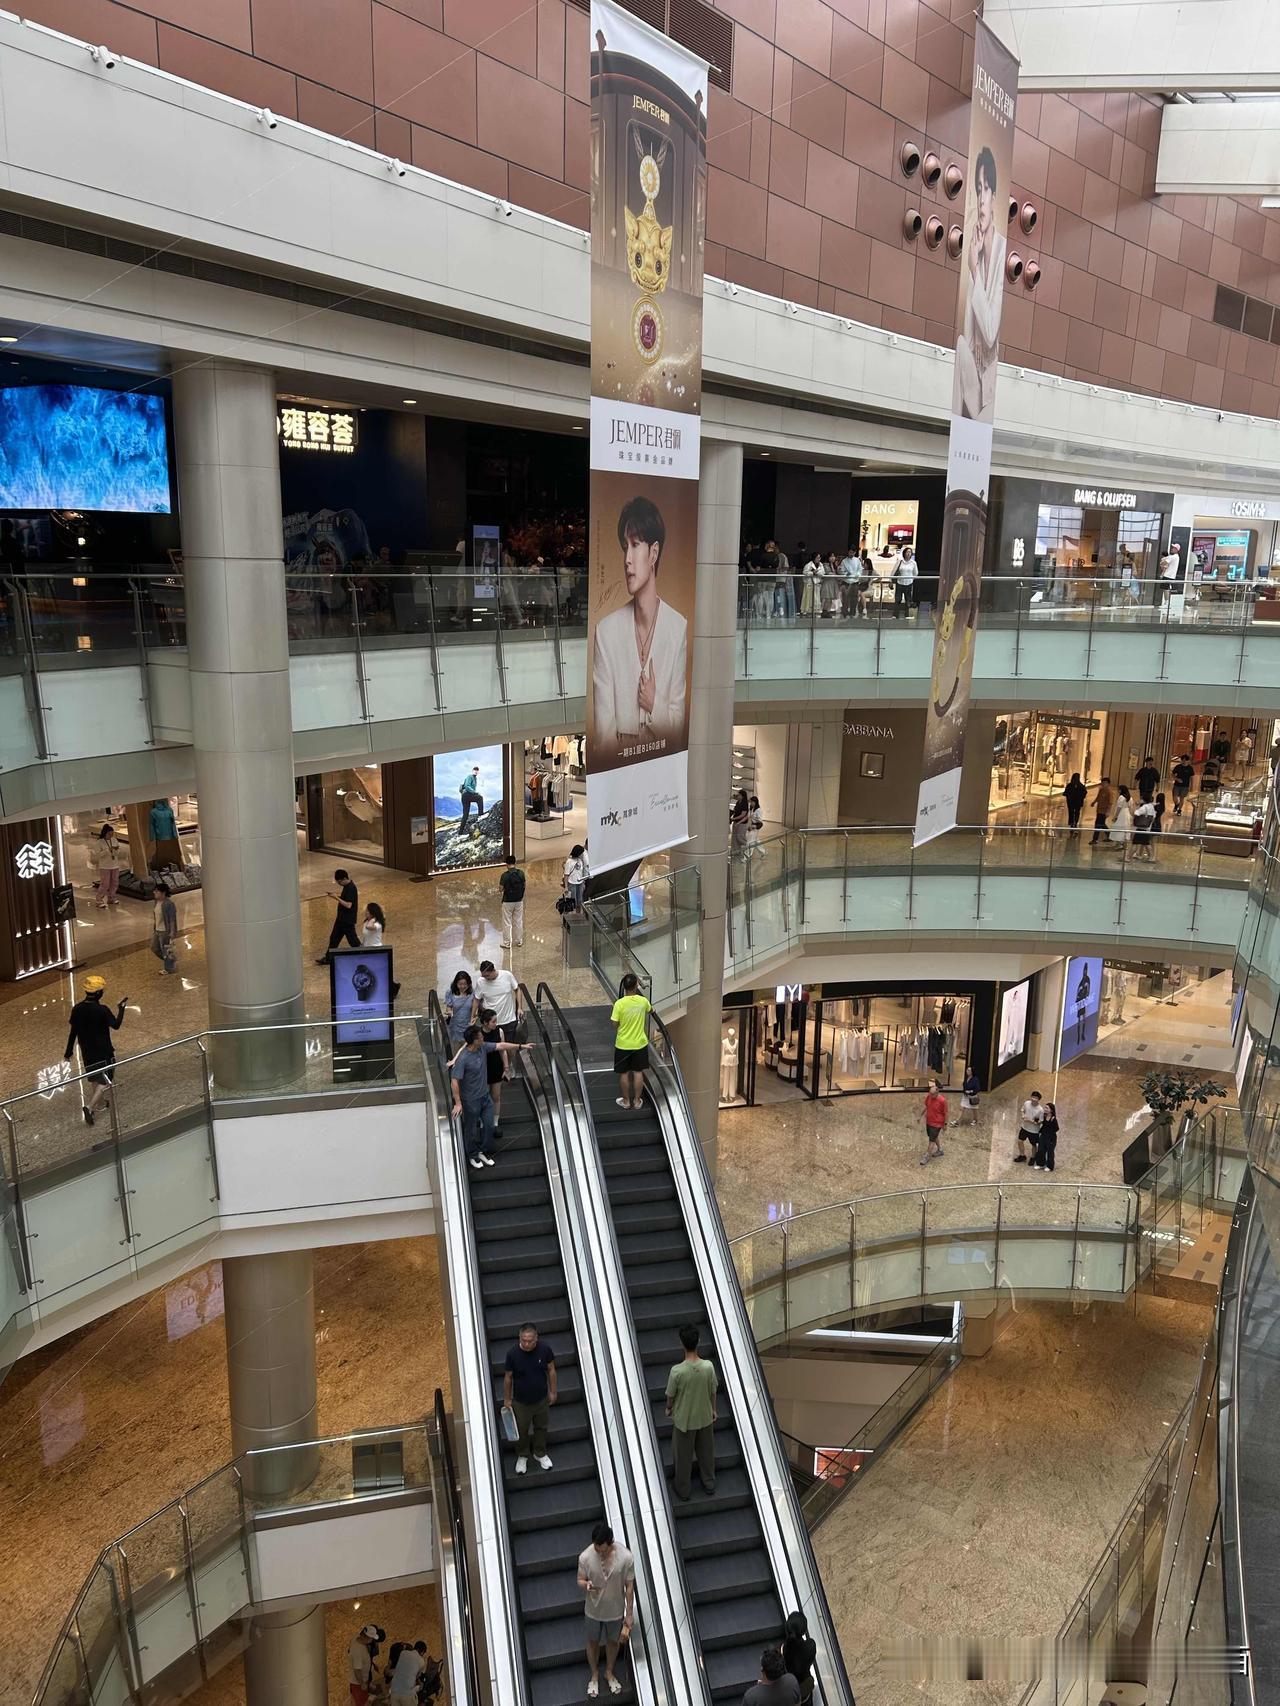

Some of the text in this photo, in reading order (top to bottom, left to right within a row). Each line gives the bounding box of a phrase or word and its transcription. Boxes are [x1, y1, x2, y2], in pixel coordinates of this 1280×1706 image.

[281, 408, 354, 445] 雍容荟
[333, 444, 354, 453] BUFFET
[1074, 489, 1136, 508] BANG & OLUFSEN
[863, 503, 915, 514] BANG &
